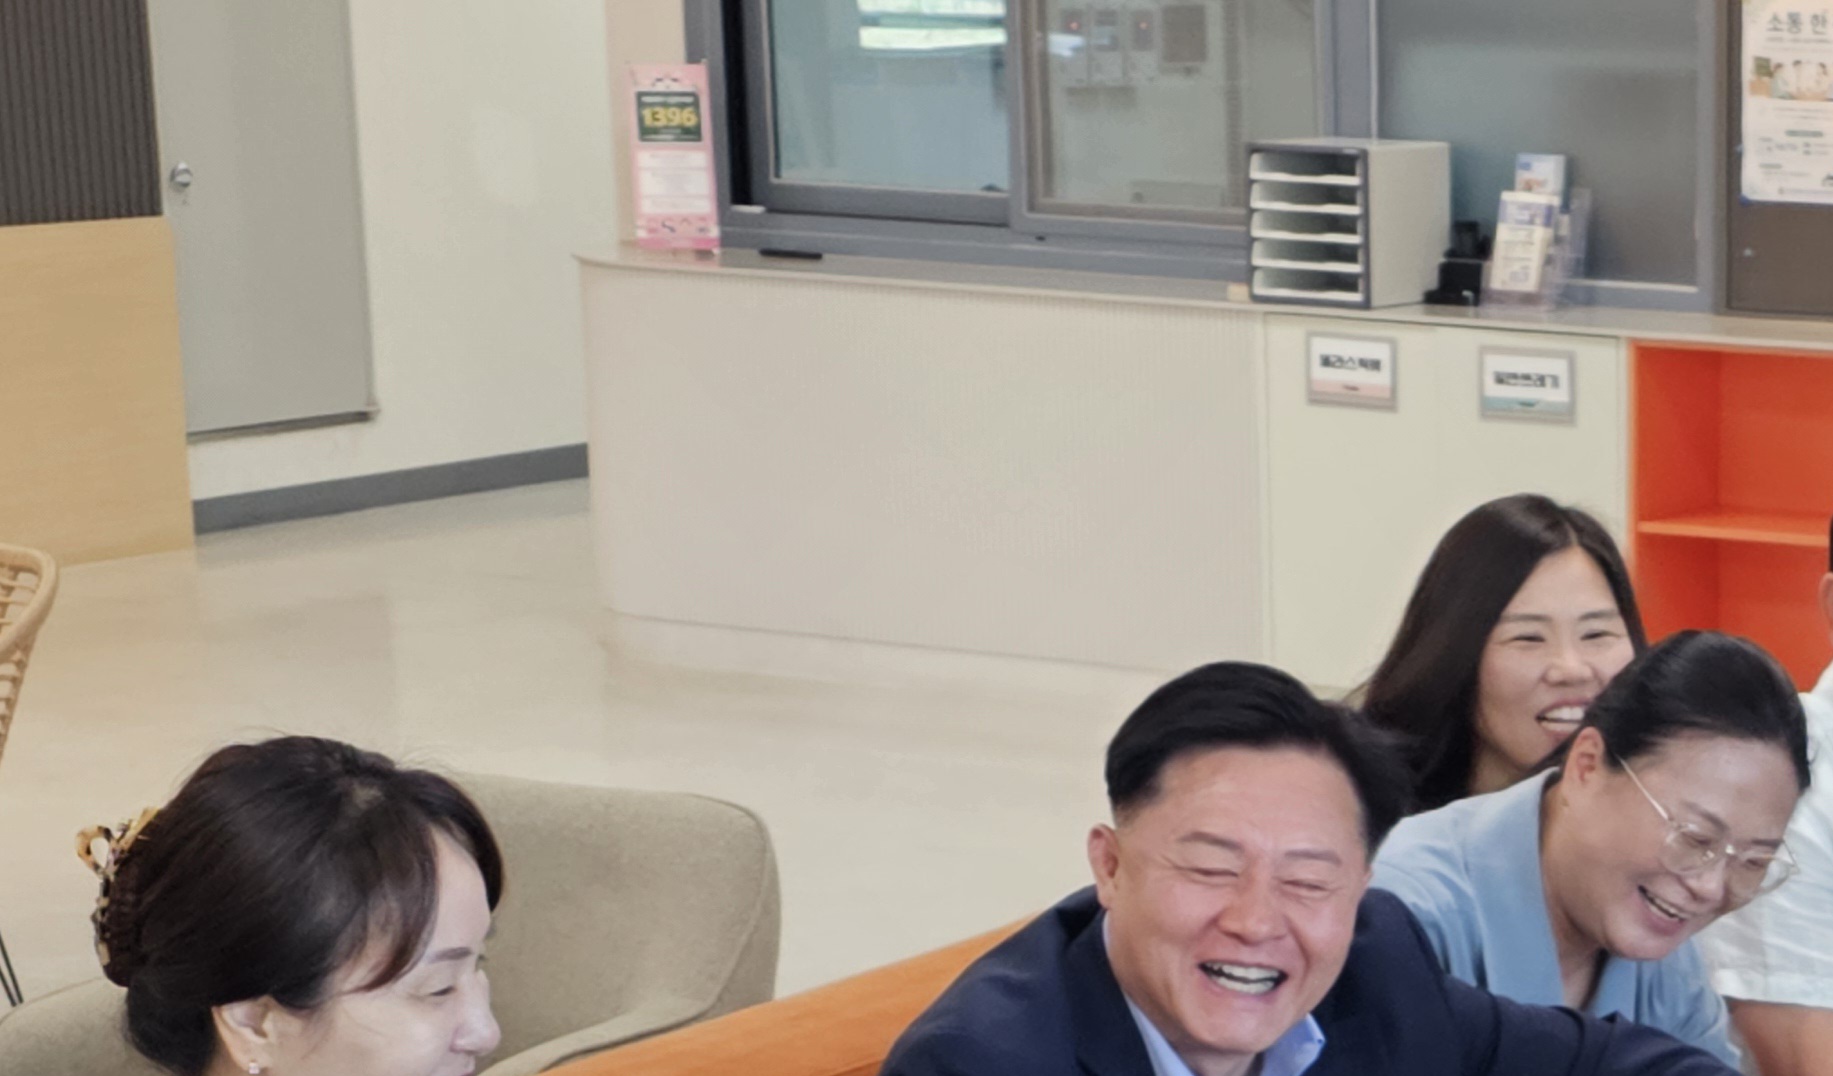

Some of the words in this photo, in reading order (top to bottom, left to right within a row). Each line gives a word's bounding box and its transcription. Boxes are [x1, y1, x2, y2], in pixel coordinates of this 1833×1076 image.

[1765, 11, 1802, 35] 소통
[1809, 10, 1829, 36] 한
[642, 106, 698, 128] 1396
[1493, 370, 1560, 389] 일반쓰레기
